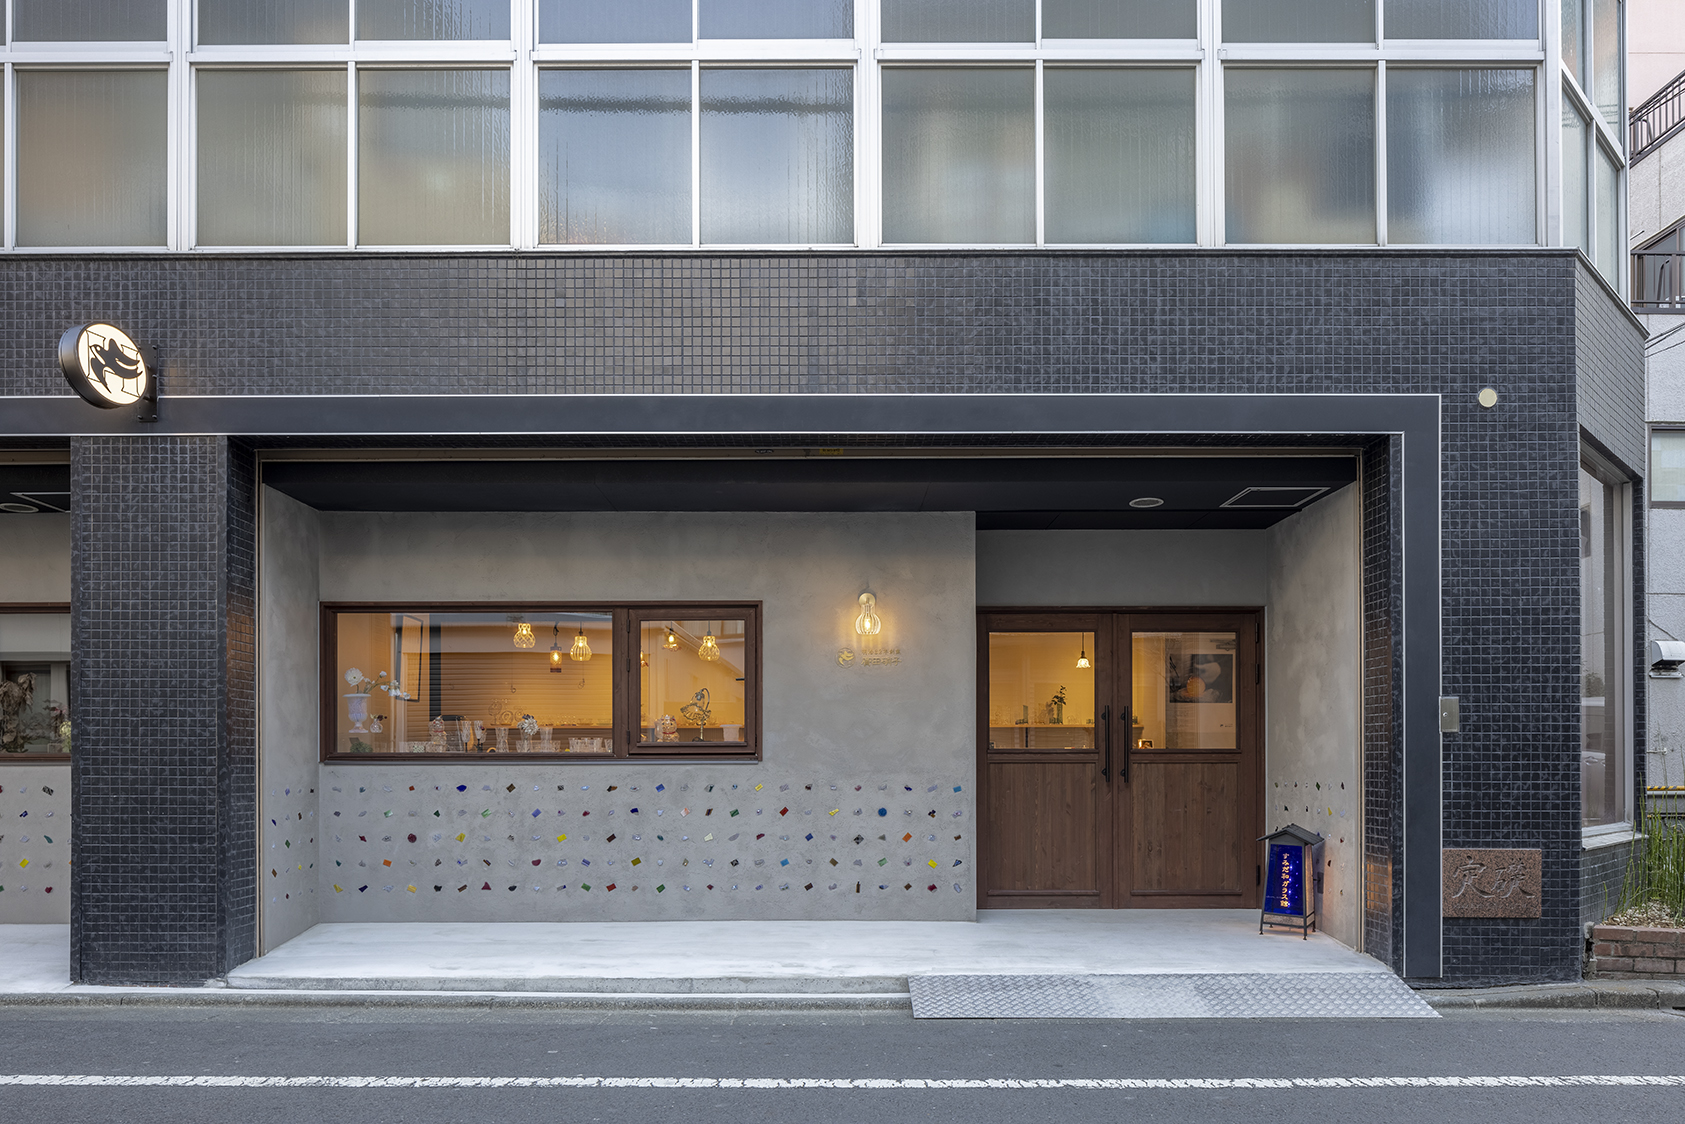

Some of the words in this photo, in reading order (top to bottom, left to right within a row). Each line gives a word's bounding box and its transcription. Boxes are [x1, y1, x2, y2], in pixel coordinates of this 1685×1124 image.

[1280, 853, 1290, 908] すみだ和ガラス館
[1452, 855, 1536, 899] 定礎
